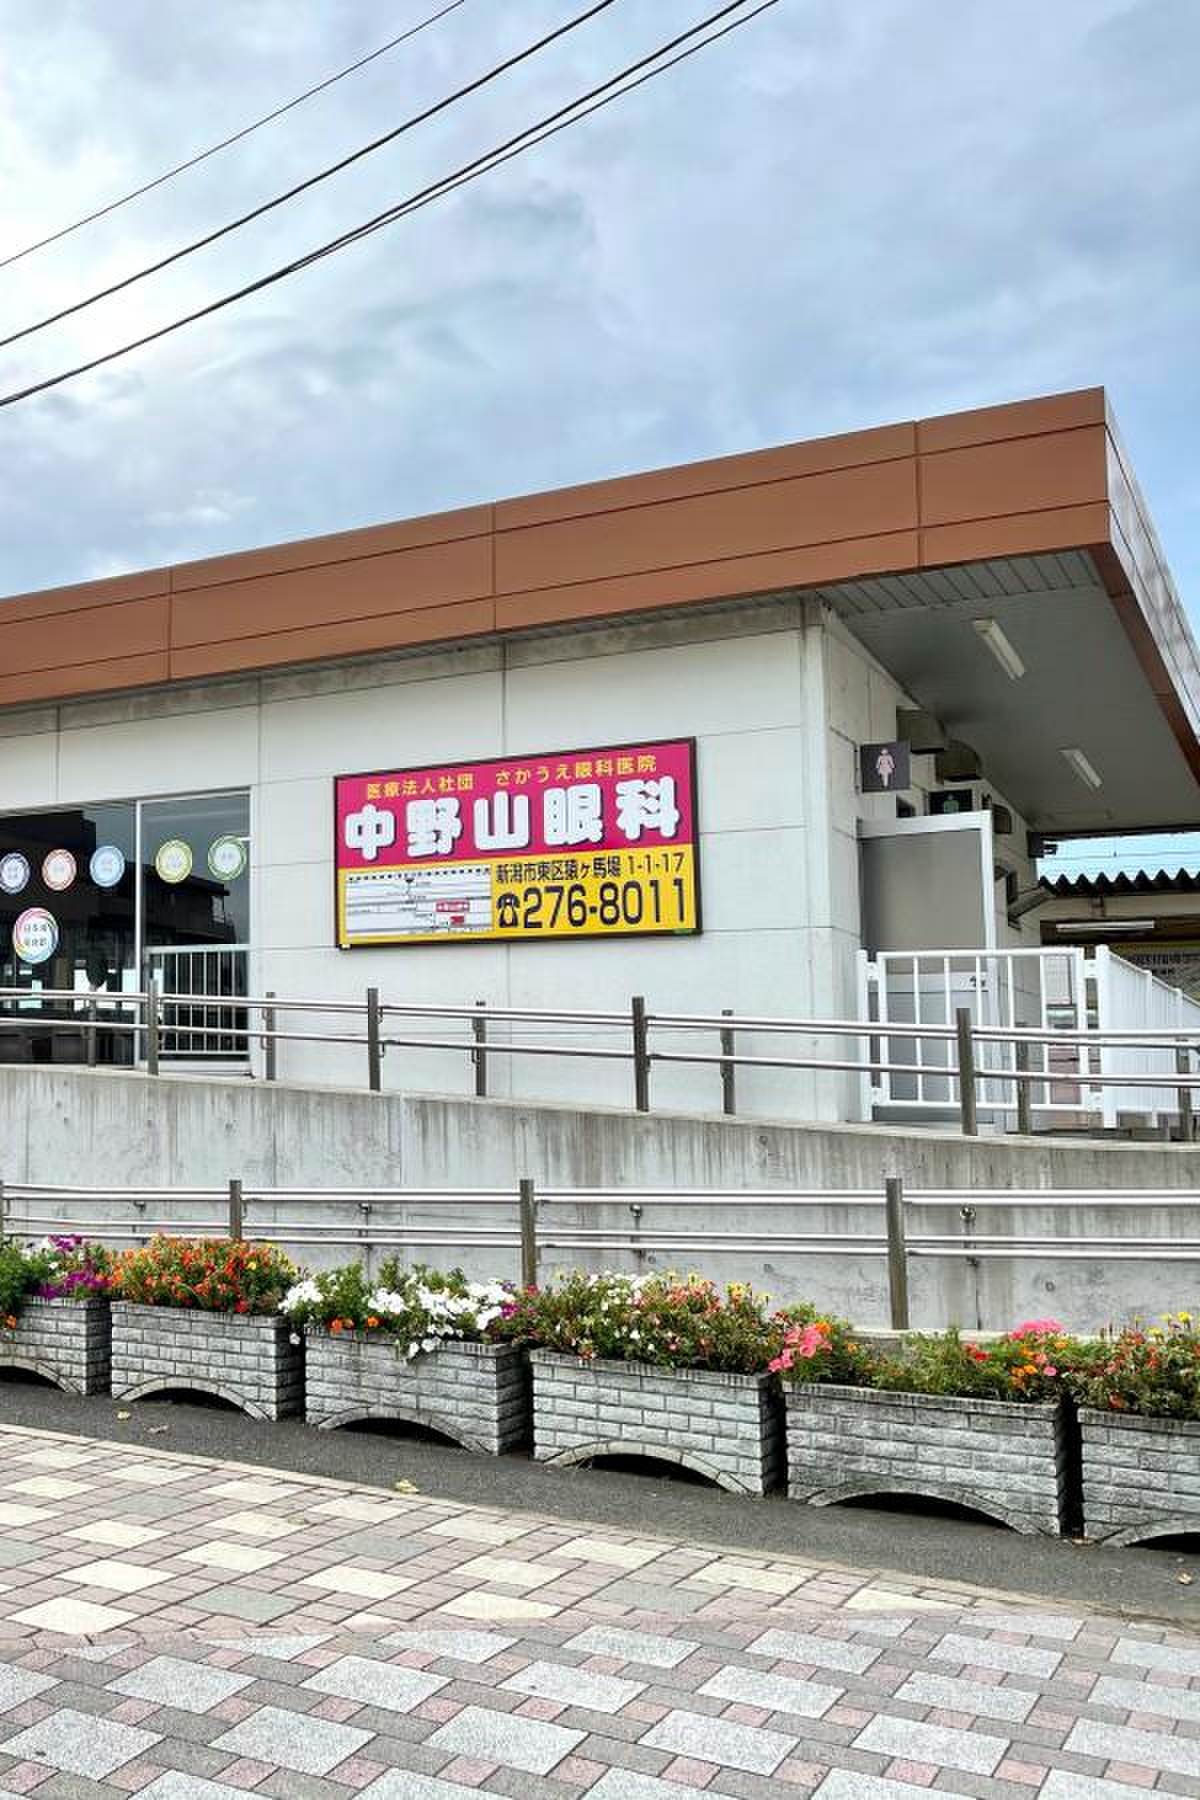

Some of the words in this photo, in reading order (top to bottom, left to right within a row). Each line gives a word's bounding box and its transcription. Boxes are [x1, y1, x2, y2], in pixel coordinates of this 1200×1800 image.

[367, 773, 474, 799] 医療法人社団
[495, 755, 657, 787] さかうえ眼科医院
[345, 775, 681, 861] 中野山眼科
[628, 852, 685, 875] 1-1-17
